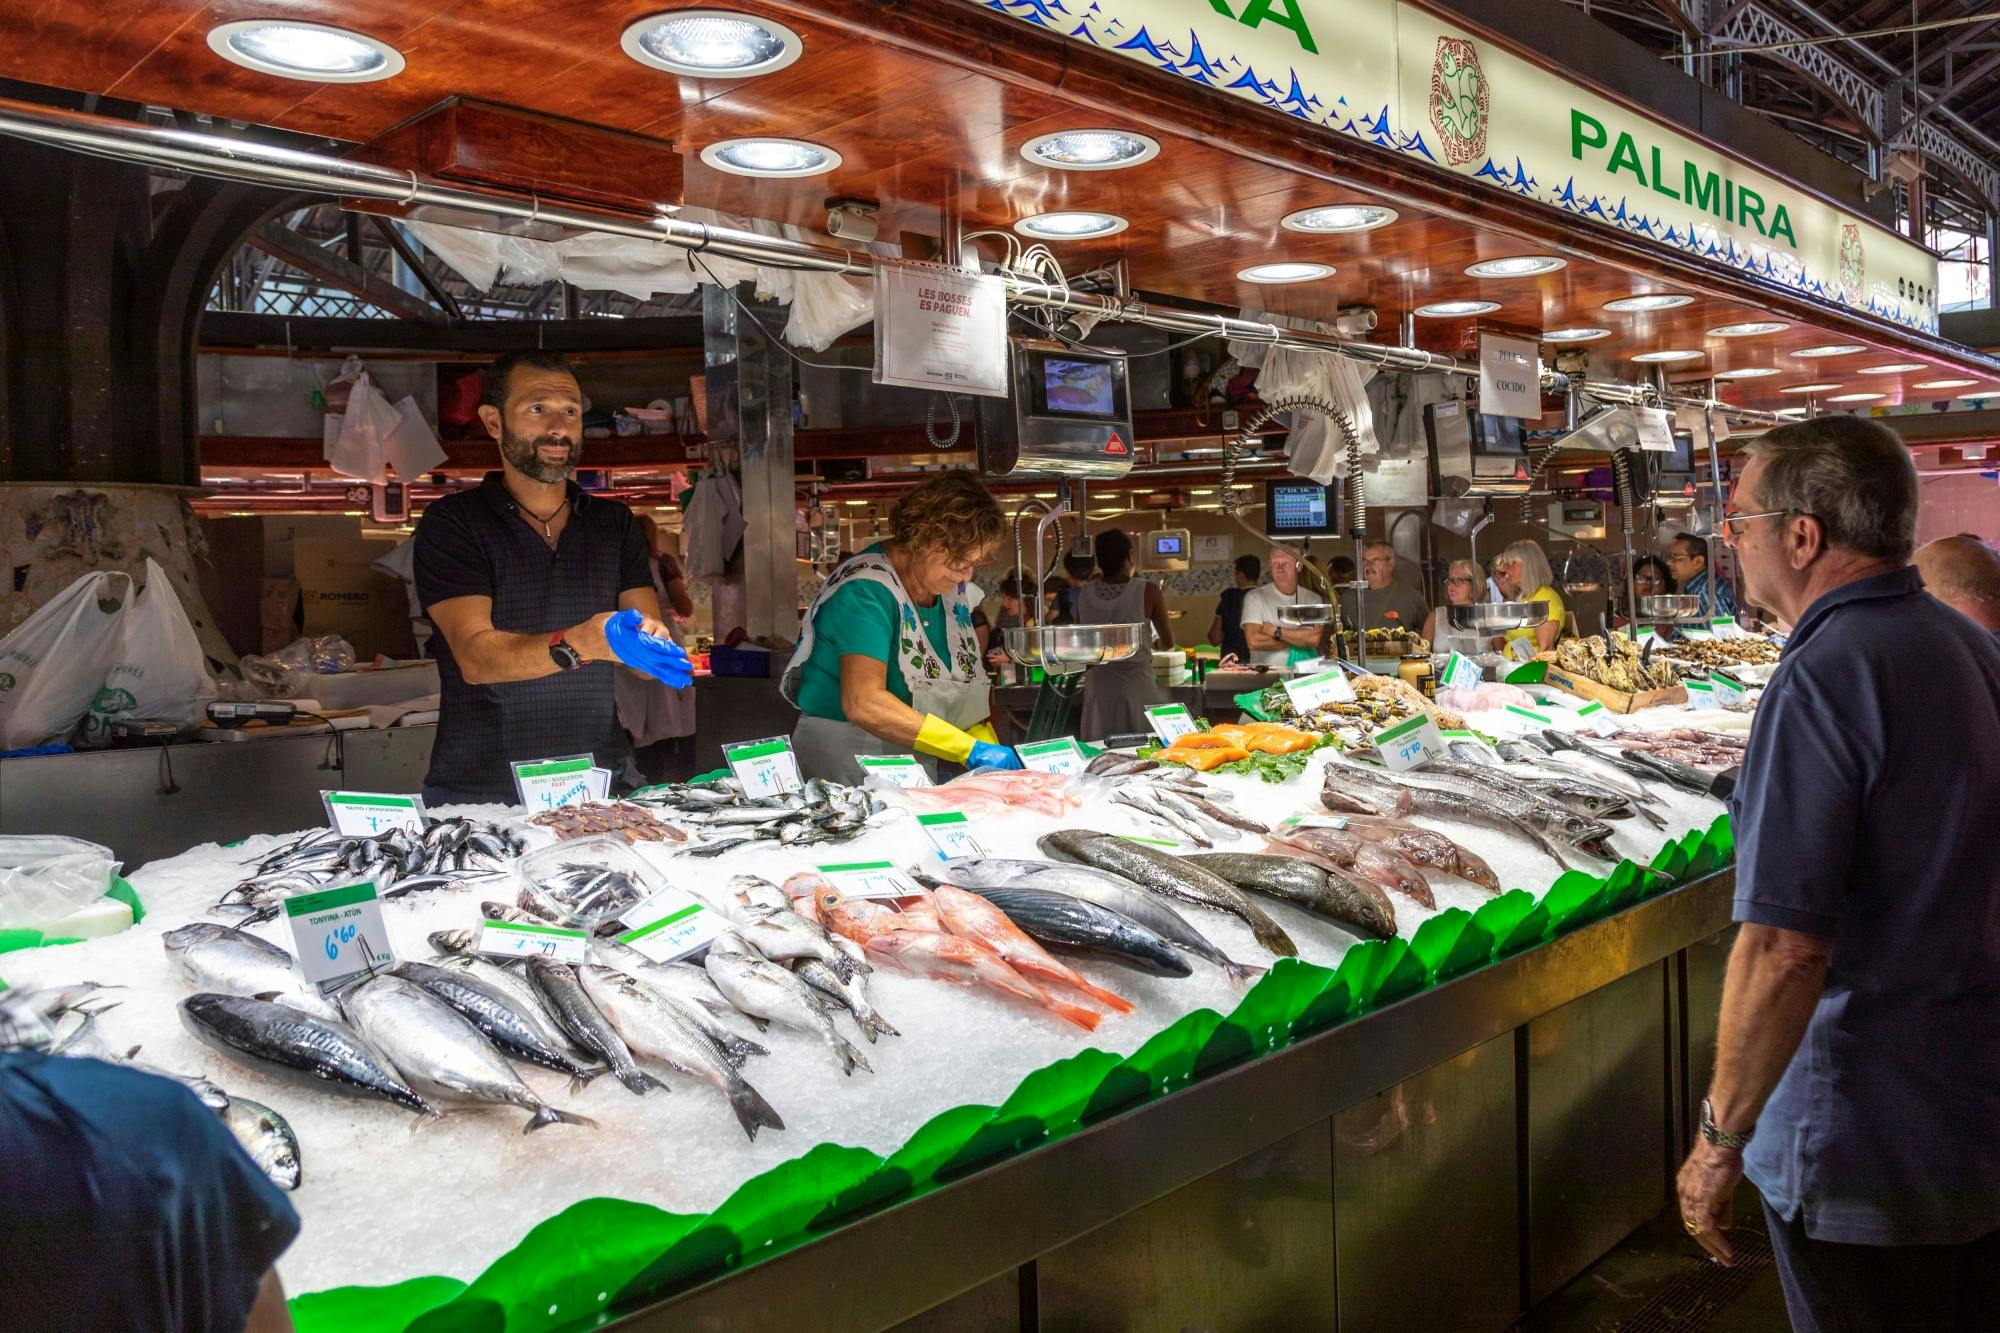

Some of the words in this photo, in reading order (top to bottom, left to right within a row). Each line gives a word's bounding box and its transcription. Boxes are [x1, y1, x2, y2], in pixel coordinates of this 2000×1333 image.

[1570, 108, 1798, 249] PALMIRA
[918, 287, 936, 300] LES
[937, 291, 973, 307] BOSSES
[919, 299, 932, 312] ES
[1496, 379, 1526, 393] COCIDO
[320, 592, 369, 601] ROMERO
[308, 911, 340, 926] TONYINA
[344, 907, 362, 920] ATÚN
[324, 923, 356, 961] 6'60
